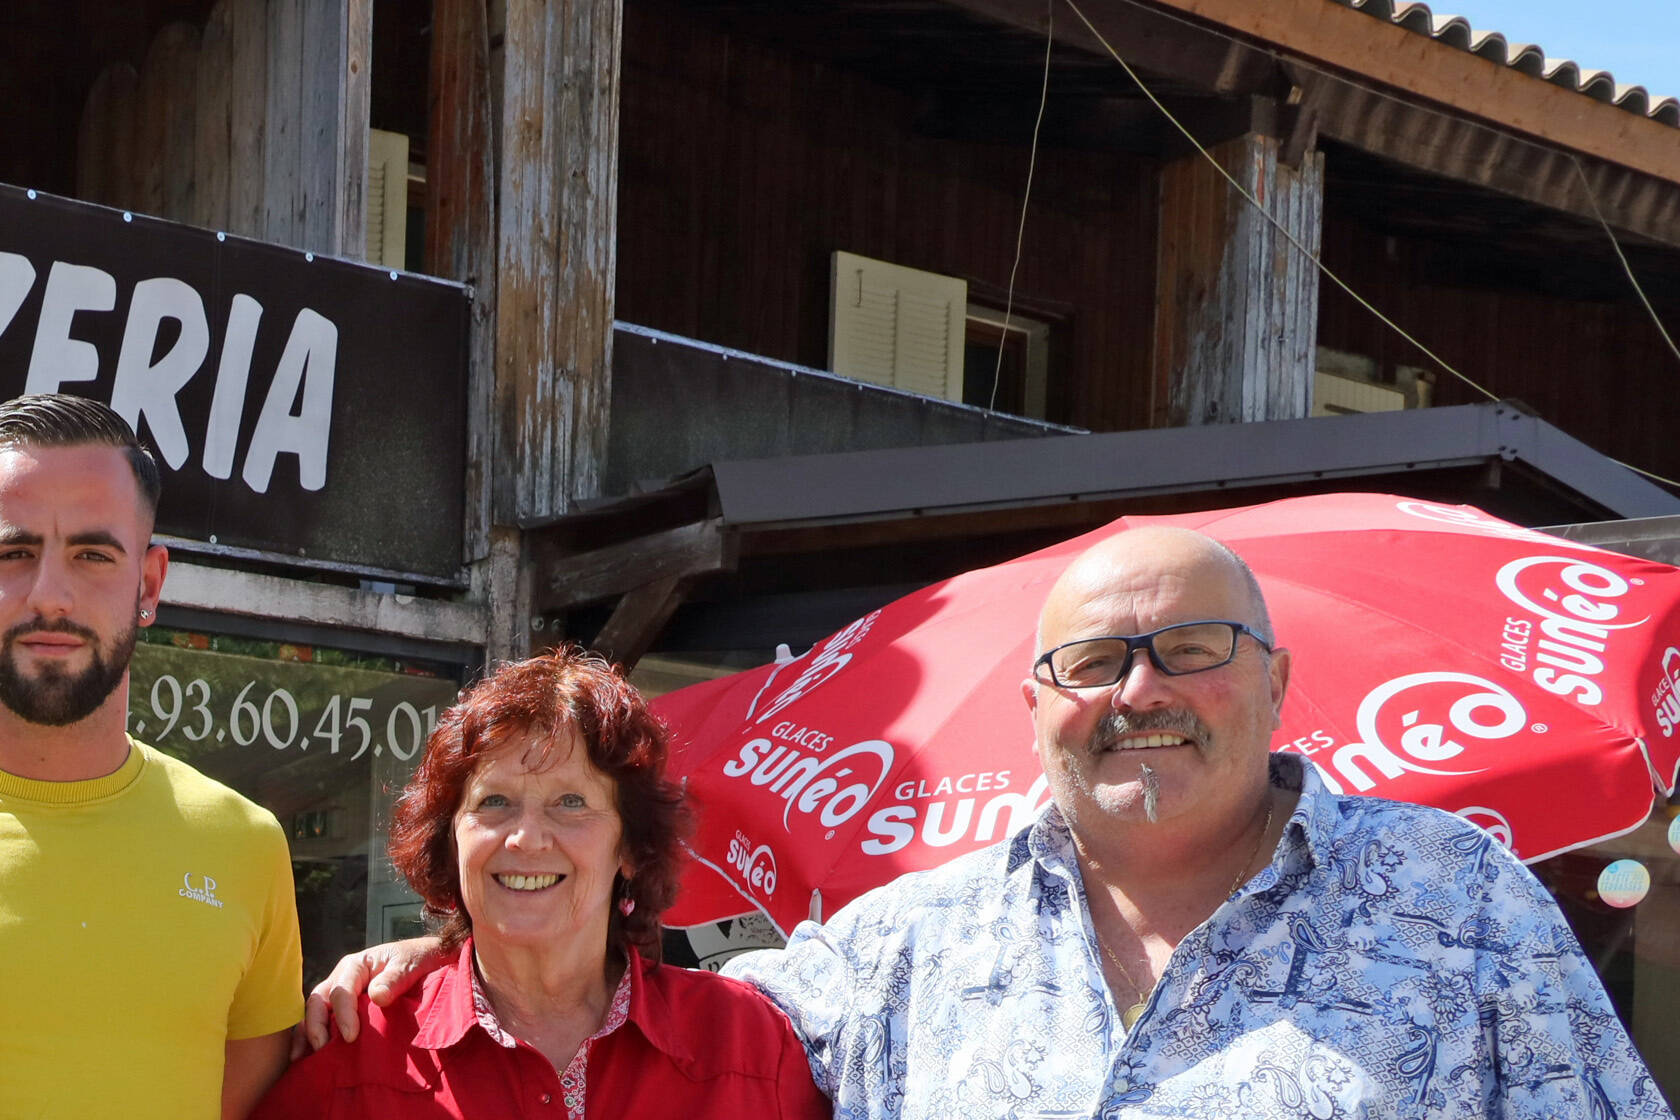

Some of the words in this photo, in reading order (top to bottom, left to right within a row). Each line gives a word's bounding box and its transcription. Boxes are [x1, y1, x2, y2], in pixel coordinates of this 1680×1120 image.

[1499, 617, 1533, 672] GLACES
[125, 674, 437, 762] .93.60.45.01
[772, 721, 835, 753] GLACES
[895, 770, 1012, 801] GLACES
[860, 785, 1048, 856] sun
